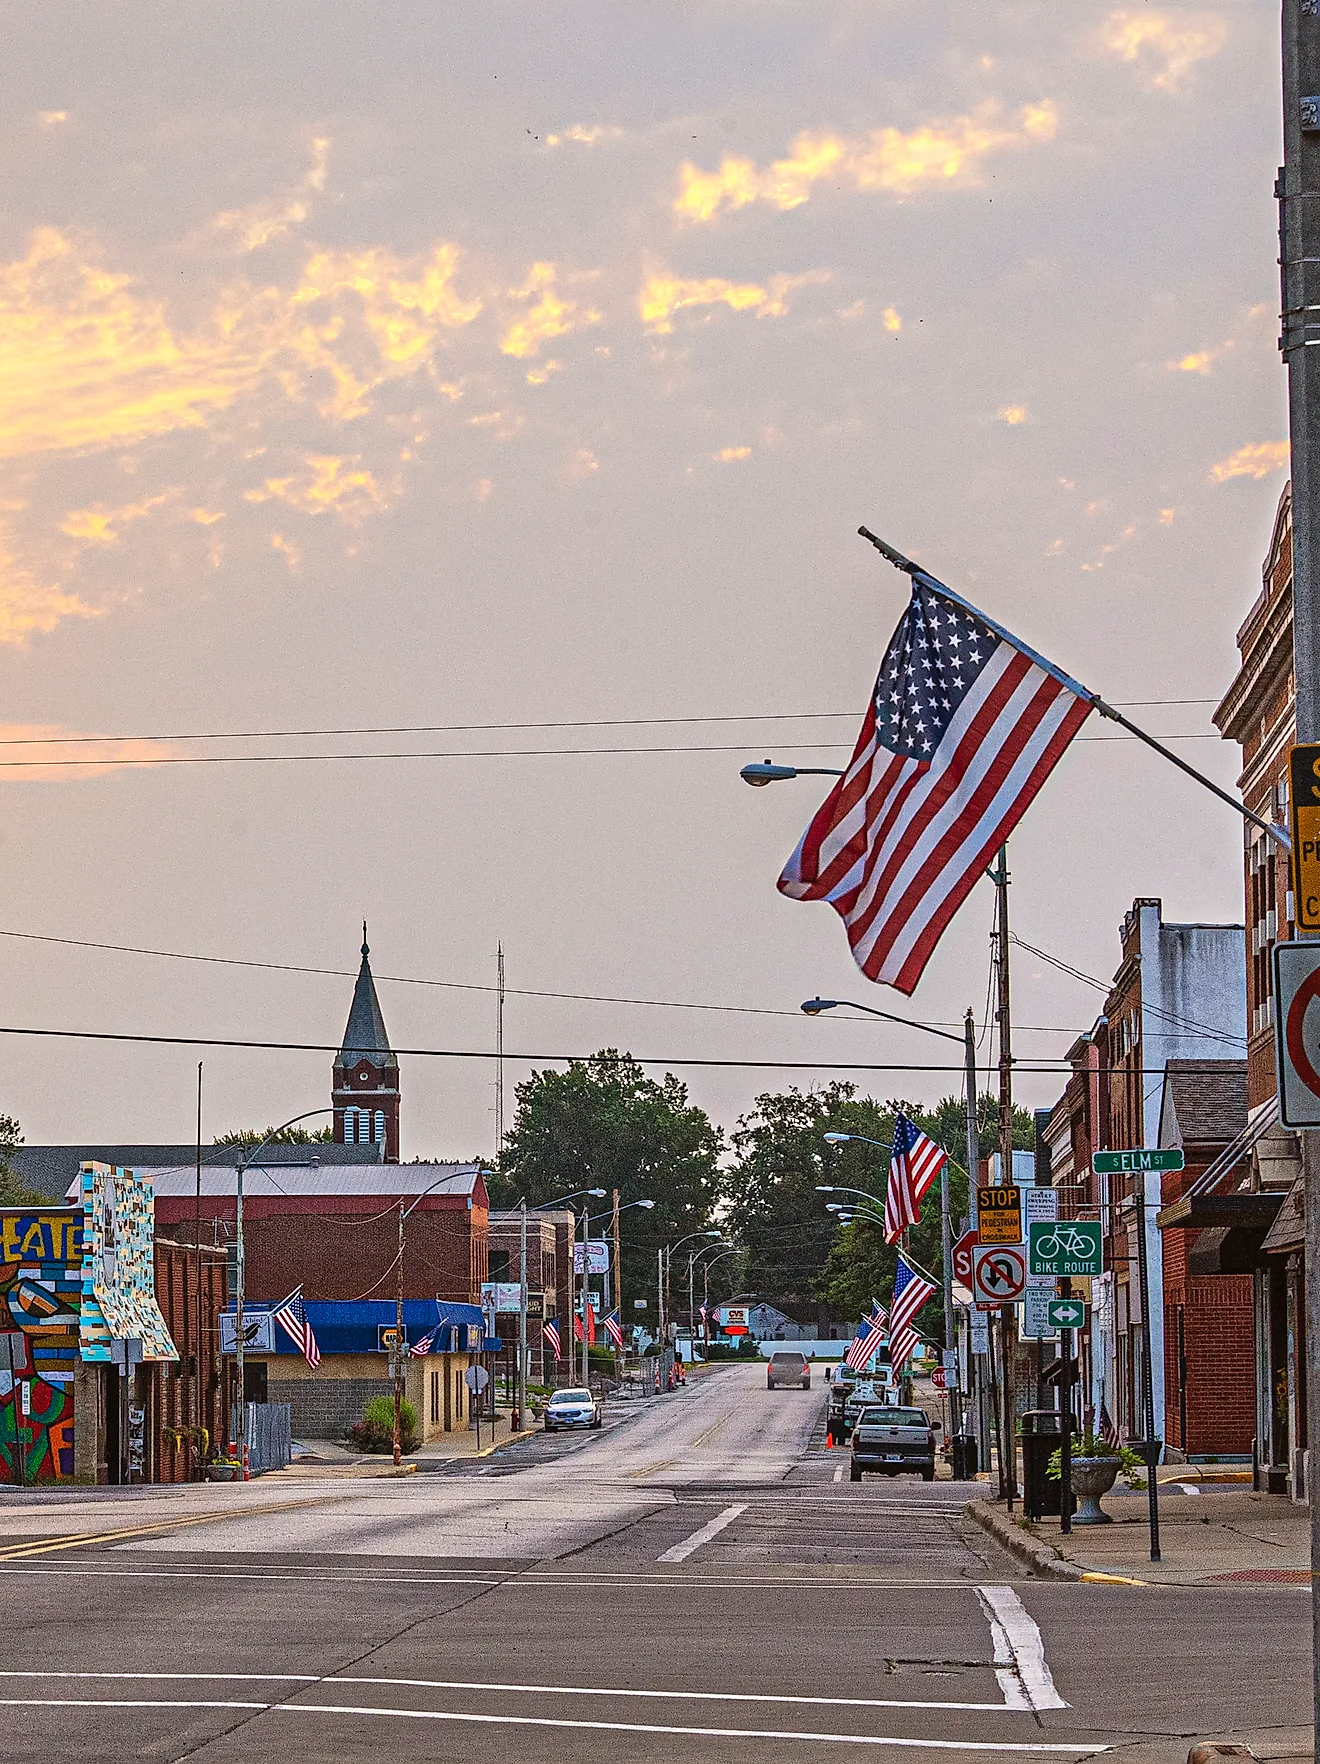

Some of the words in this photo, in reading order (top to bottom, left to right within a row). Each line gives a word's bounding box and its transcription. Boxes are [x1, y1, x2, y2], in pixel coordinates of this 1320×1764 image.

[1113, 1158, 1119, 1167] S
[1121, 1153, 1152, 1170] ELM
[1154, 1156, 1163, 1165] ST
[980, 1189, 1017, 1206] STOP
[1035, 1261, 1058, 1273] BIKE
[1064, 1261, 1096, 1273] ROUTE
[728, 1310, 744, 1318] CVS
